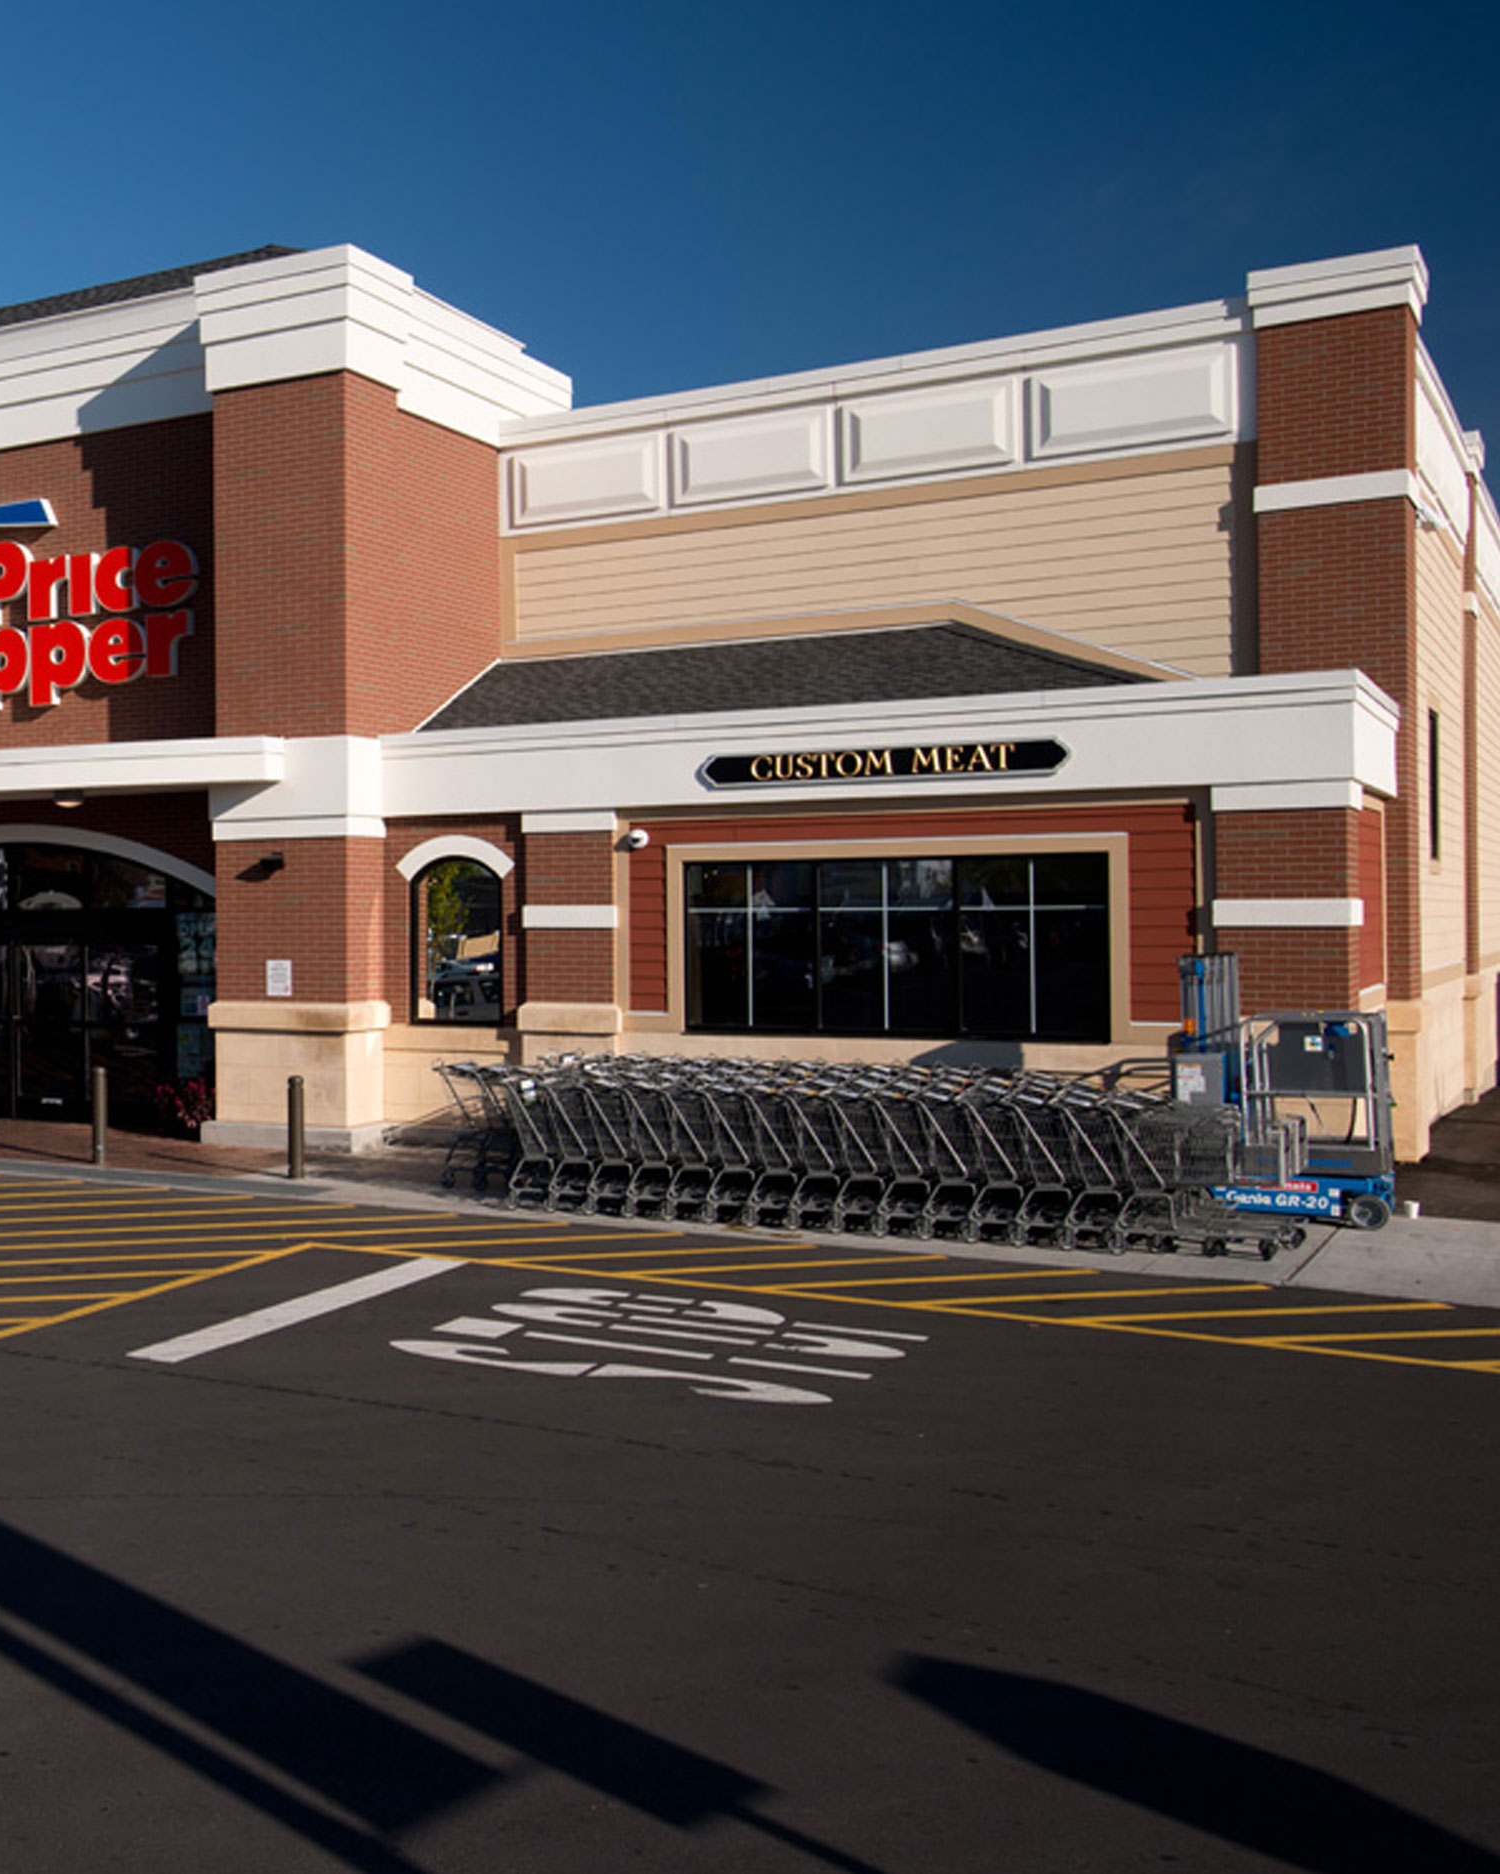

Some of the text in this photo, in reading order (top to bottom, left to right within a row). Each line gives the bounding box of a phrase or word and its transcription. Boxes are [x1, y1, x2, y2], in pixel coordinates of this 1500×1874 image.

[750, 743, 1015, 781] CUSTOM MEAT
[1226, 1189, 1330, 1210] Genie GR-20
[389, 1287, 929, 1404] STOP
